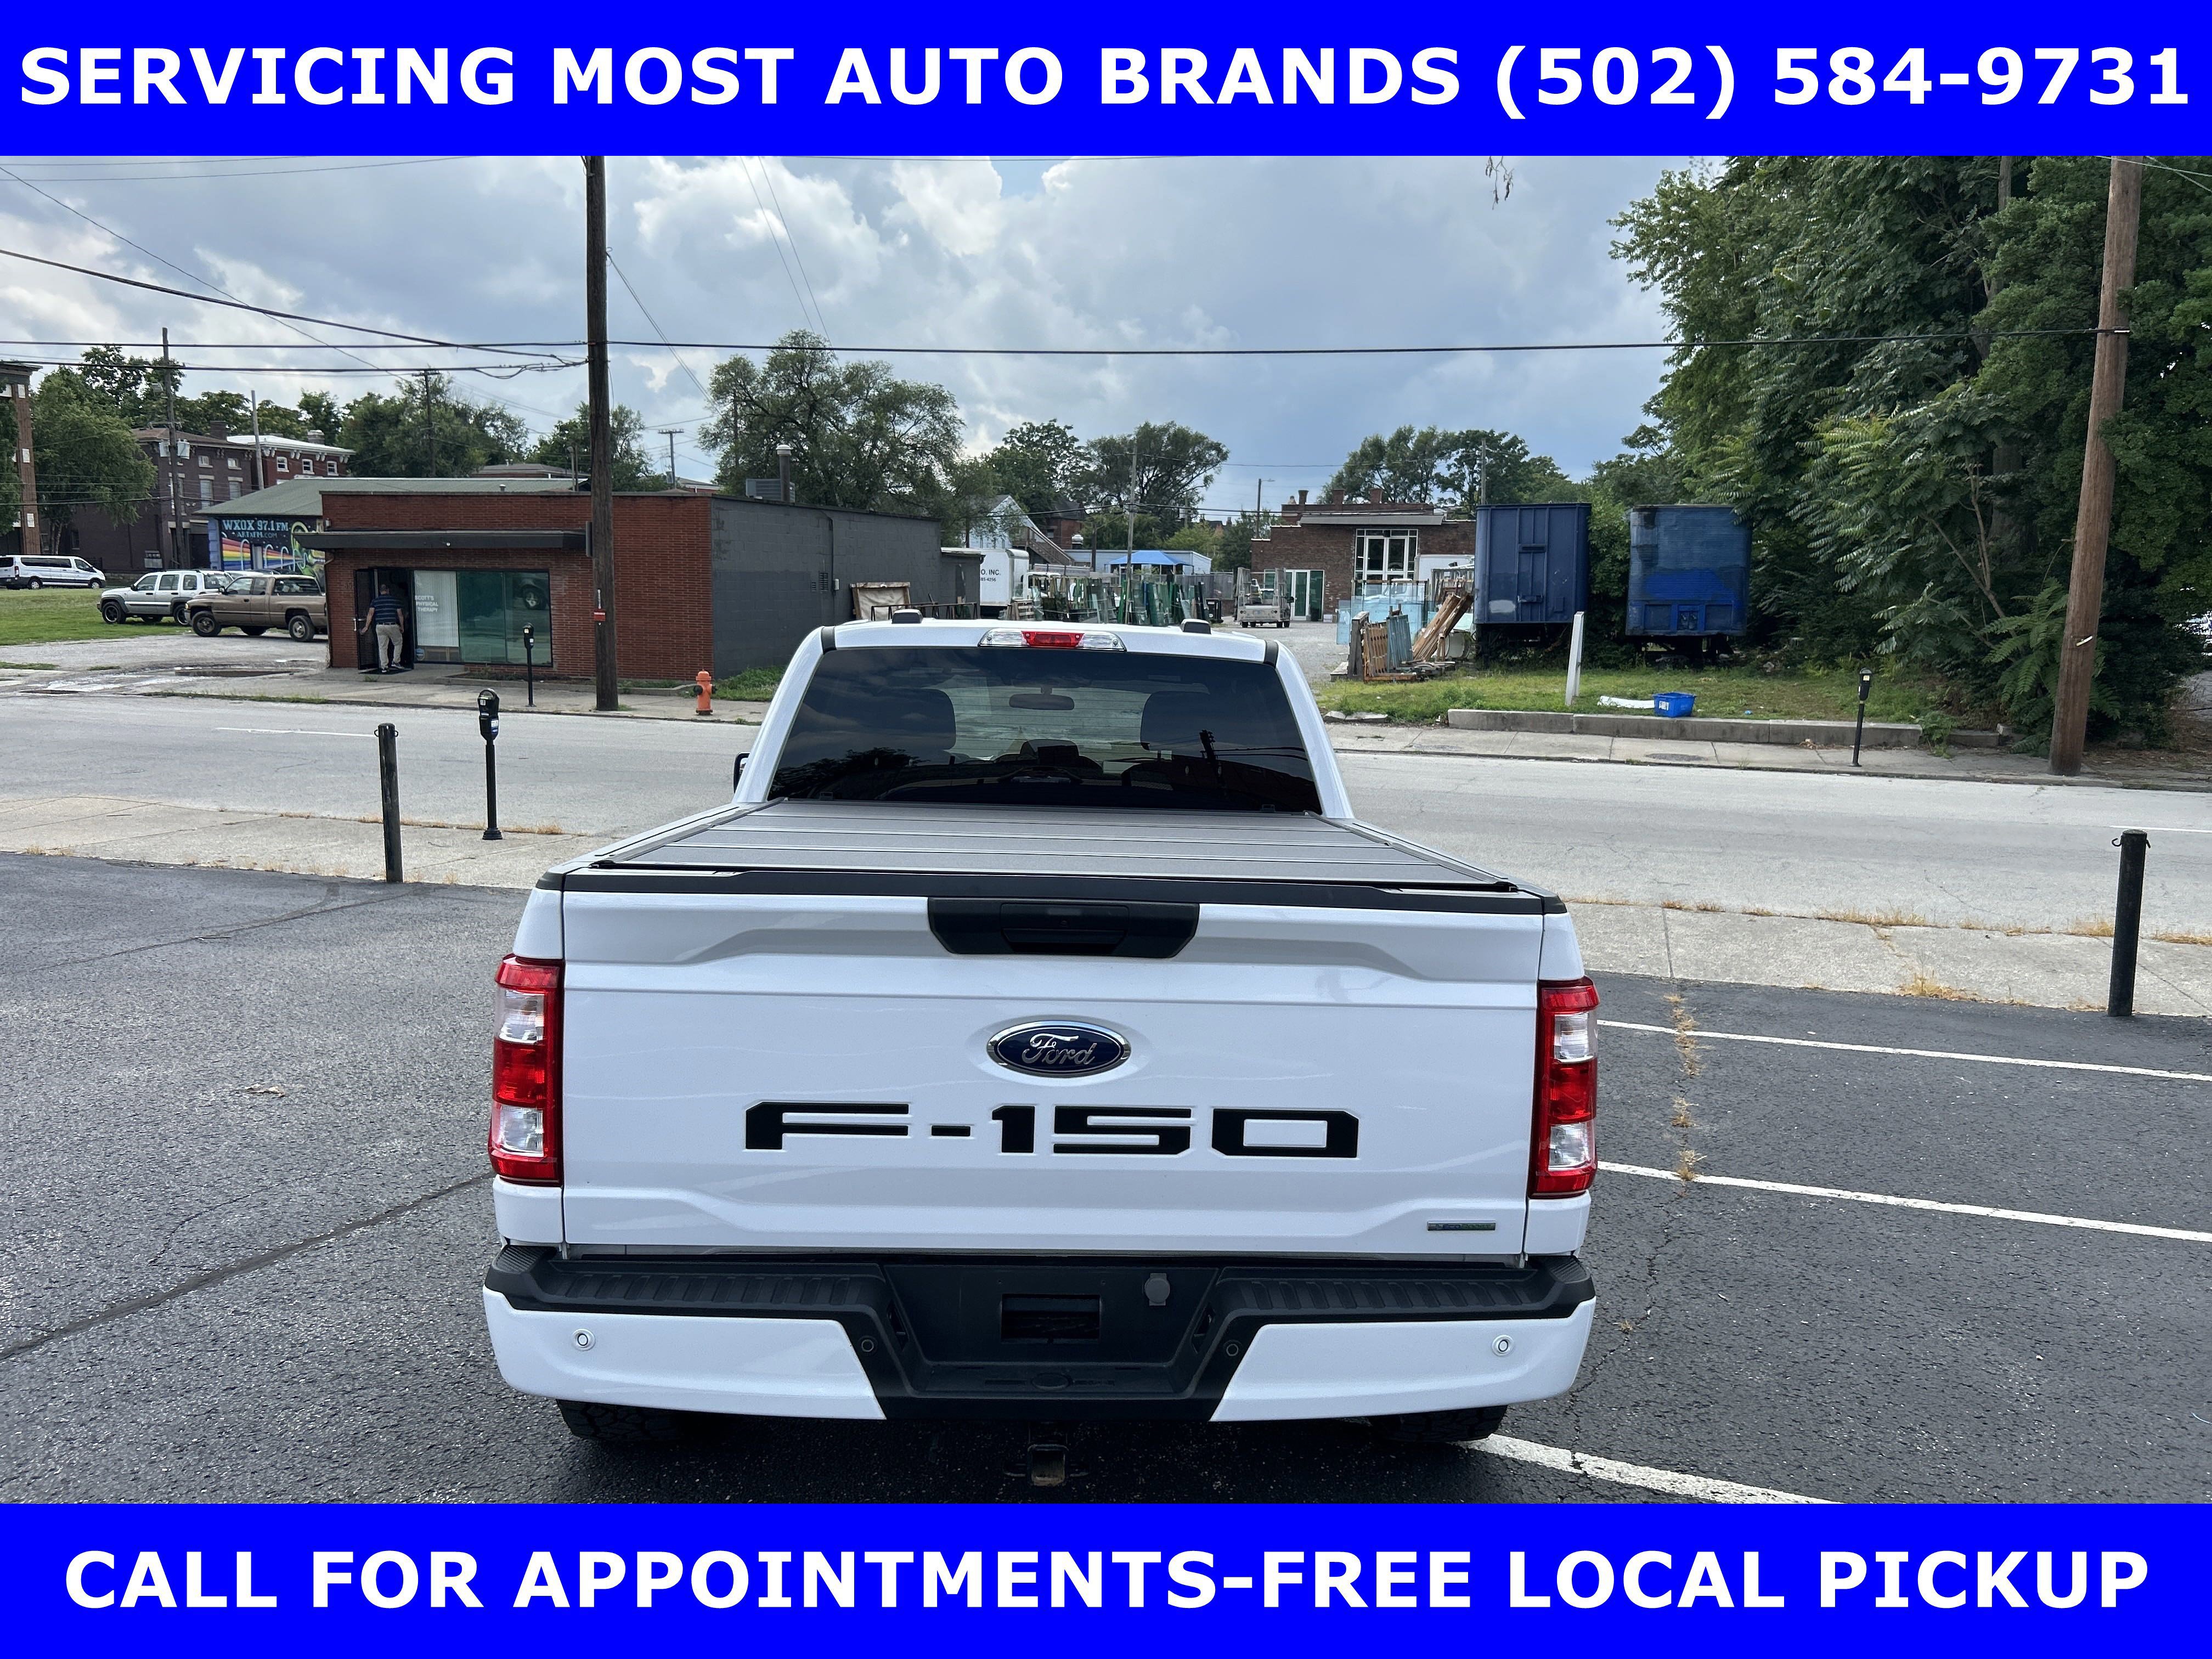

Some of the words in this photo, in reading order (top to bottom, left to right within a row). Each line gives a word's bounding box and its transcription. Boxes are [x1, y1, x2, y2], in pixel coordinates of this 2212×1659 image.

[222, 520, 255, 531] WXOX
[257, 520, 275, 531] 97.1
[276, 522, 289, 531] FM
[1022, 1033, 1097, 1065] Ford
[746, 1102, 1358, 1158] F-150
